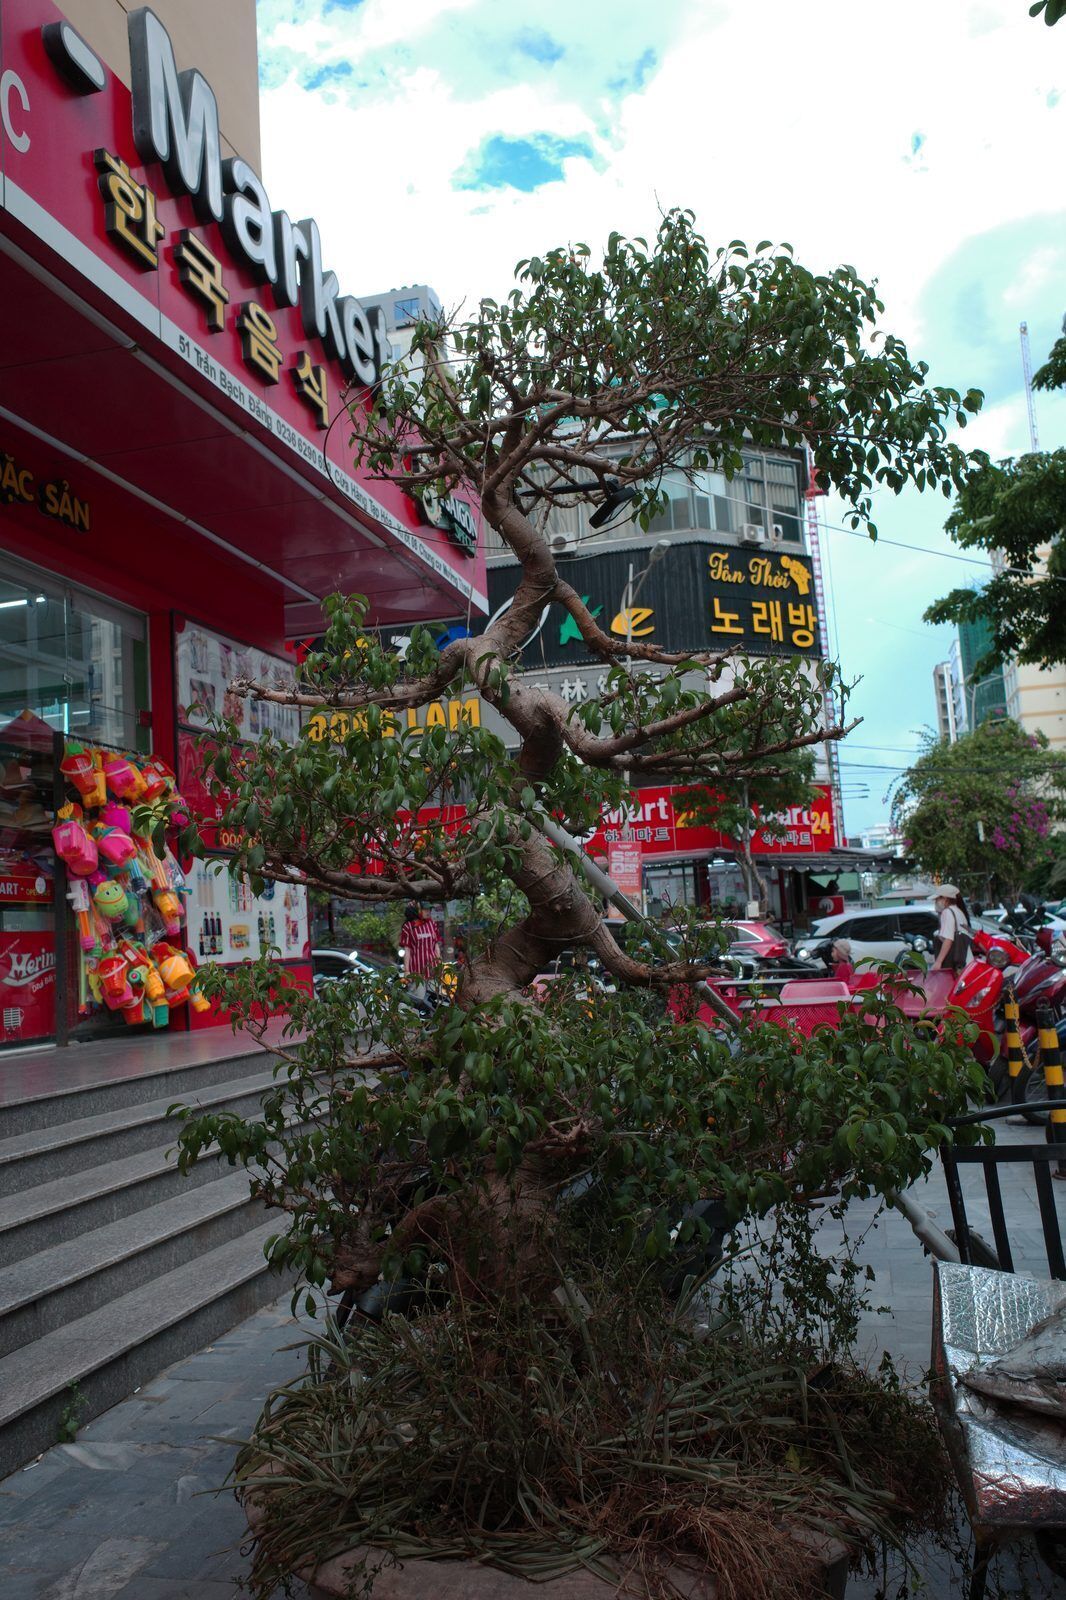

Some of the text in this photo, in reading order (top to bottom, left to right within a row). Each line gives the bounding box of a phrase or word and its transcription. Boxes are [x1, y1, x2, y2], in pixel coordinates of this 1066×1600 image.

[99, 148, 329, 430] 한국음식
[178, 334, 191, 359] 51
[219, 369, 245, 405] Bạch
[276, 418, 298, 448] 0236
[45, 479, 90, 531] SẢN
[708, 551, 746, 585] Tân
[710, 597, 818, 648] 노래방
[811, 811, 831, 835] 24
